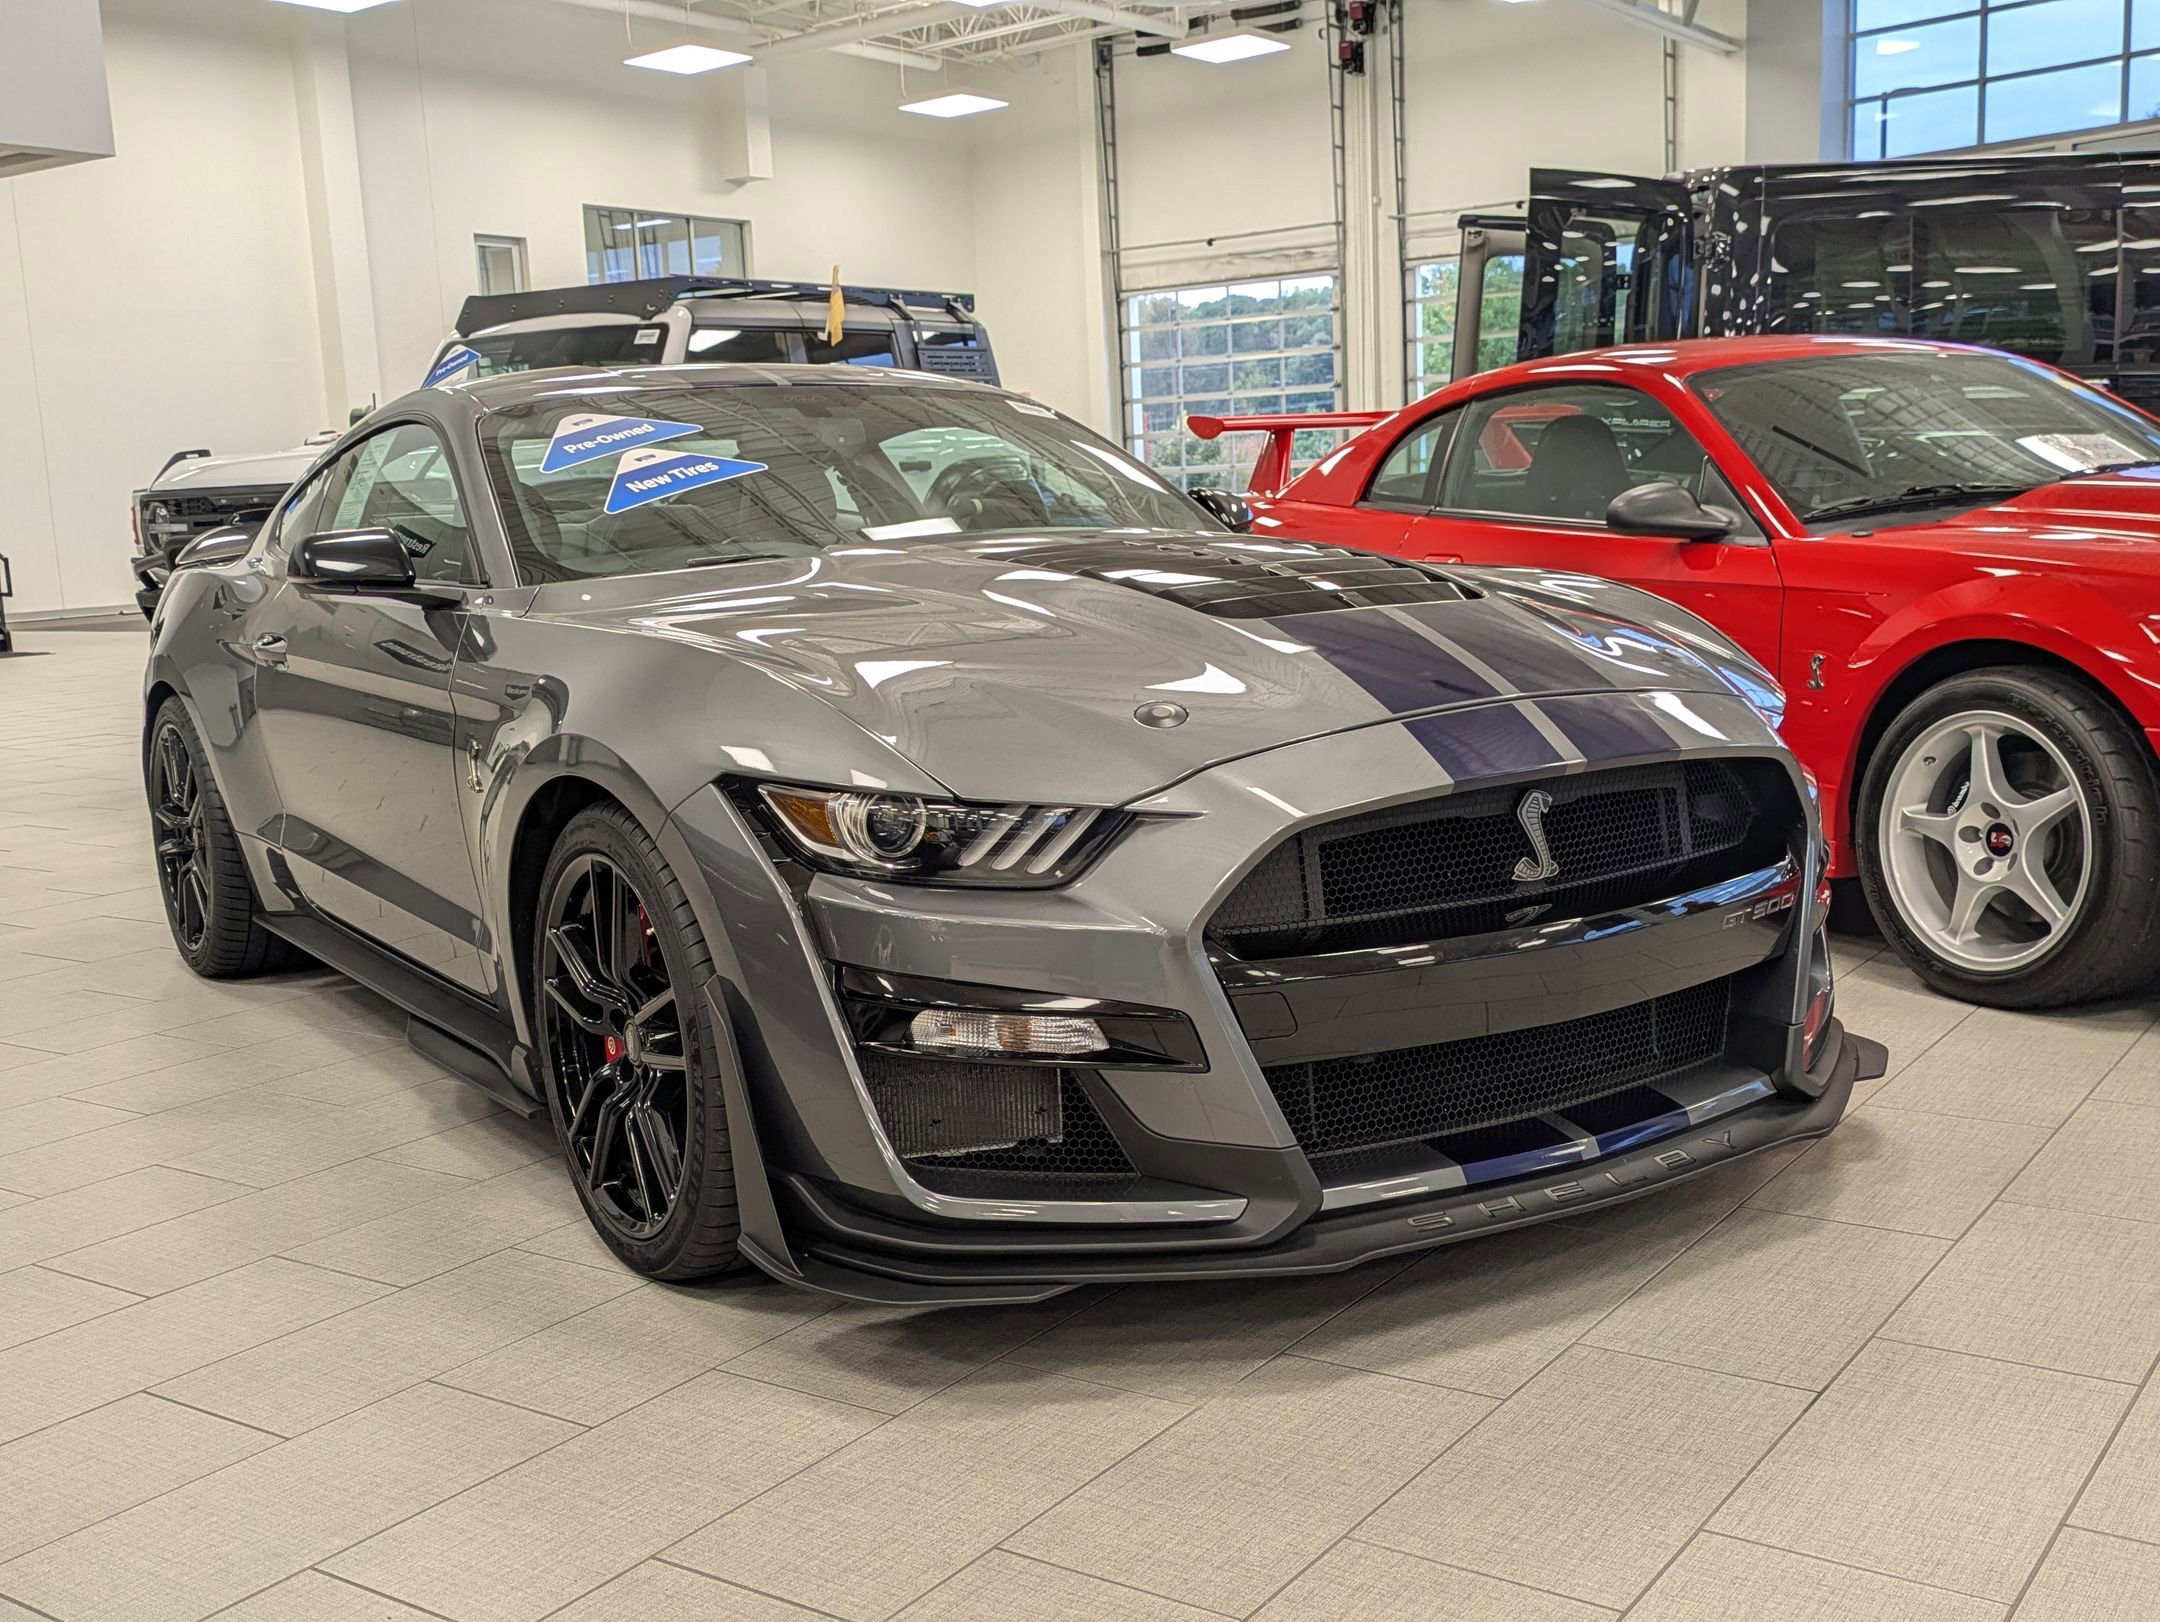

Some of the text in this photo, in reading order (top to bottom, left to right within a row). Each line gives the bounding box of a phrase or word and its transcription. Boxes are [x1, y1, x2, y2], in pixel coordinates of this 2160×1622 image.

[563, 423, 655, 454] Pre-Owned
[625, 460, 720, 494] New Tires
[1721, 891, 1794, 930] GT500
[1407, 1129, 1737, 1234] SHELBY
